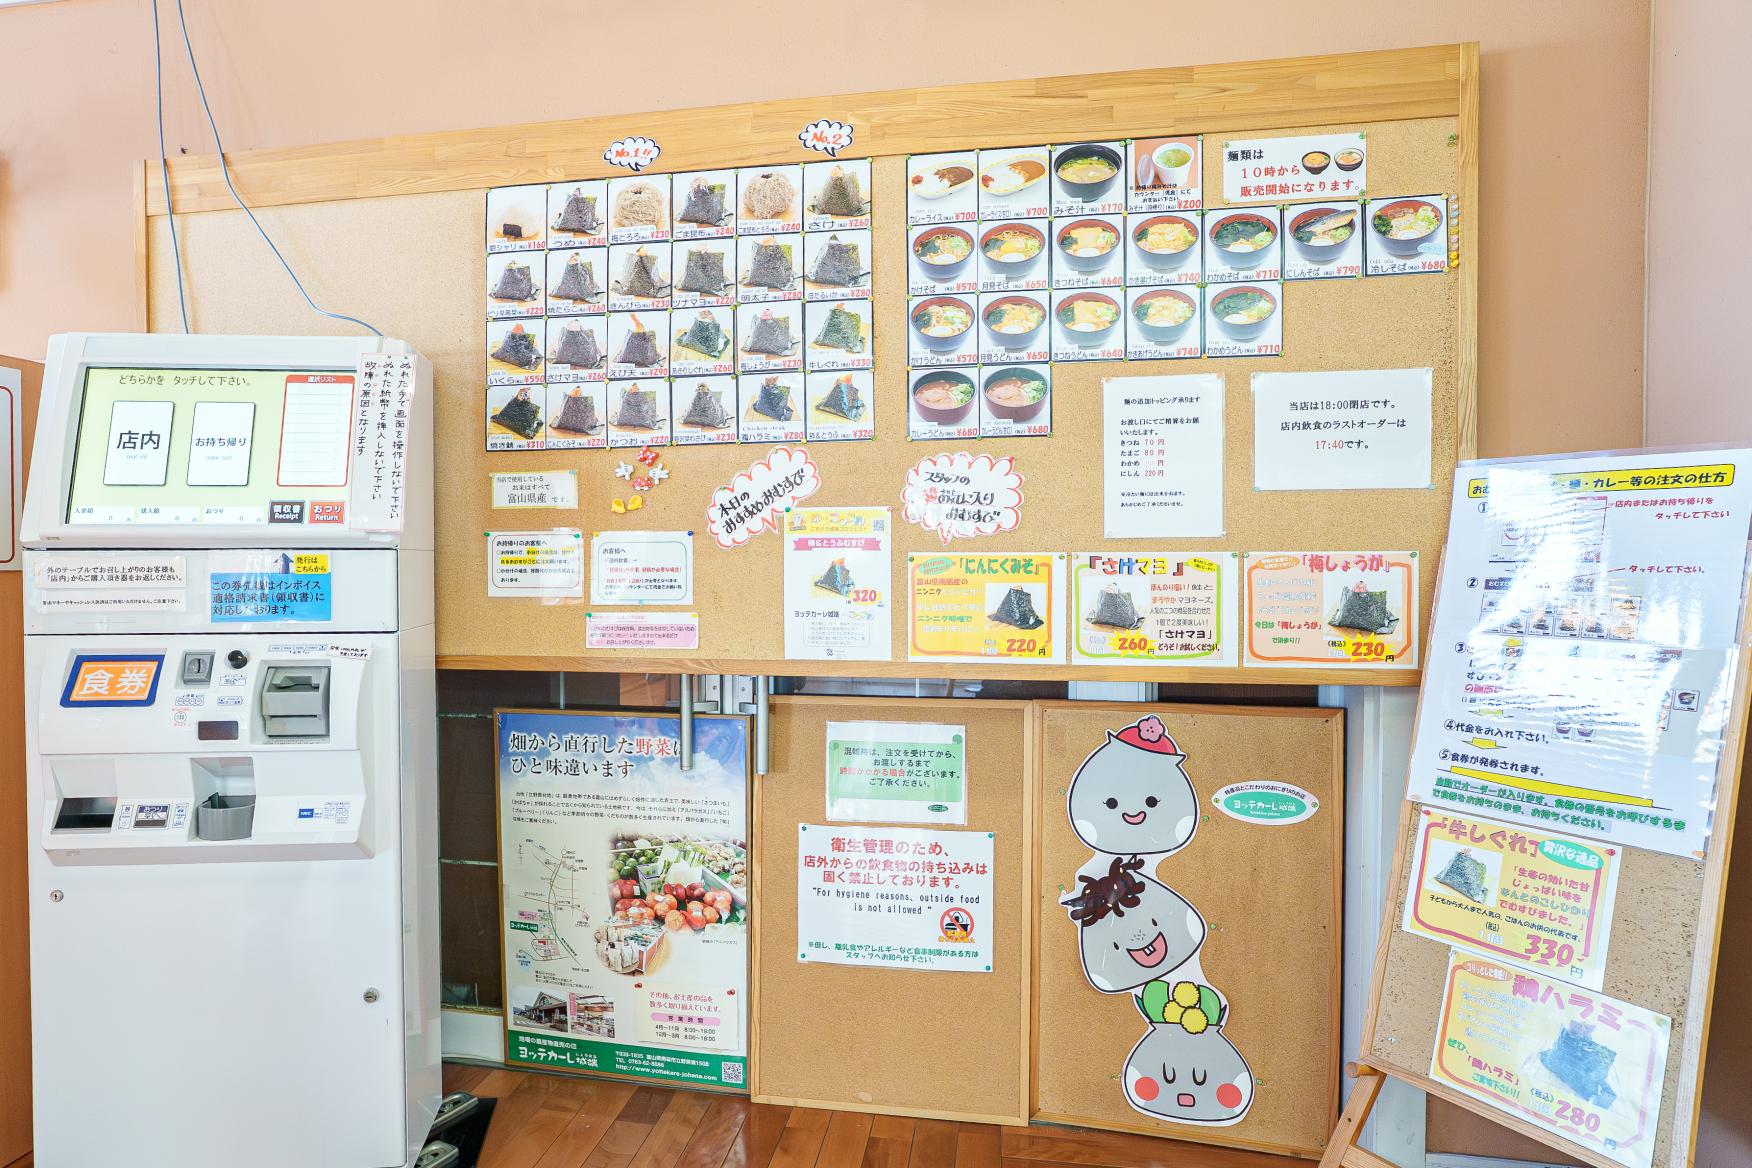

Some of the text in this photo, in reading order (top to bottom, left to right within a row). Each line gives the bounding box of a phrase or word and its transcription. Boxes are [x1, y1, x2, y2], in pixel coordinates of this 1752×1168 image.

[1227, 148, 1265, 162] 麺類は
[1240, 179, 1360, 198] 販売開始になります。
[1053, 203, 1123, 214] みそ汁 ¥170
[1177, 199, 1202, 209] ¥200
[955, 211, 976, 221] ¥700
[1026, 207, 1048, 216] ¥700
[780, 223, 801, 232] ¥240
[808, 218, 869, 229] さけ ¥260
[651, 231, 670, 239] ¥230
[674, 227, 735, 239] ごま昆布 ¥240
[527, 240, 546, 250] ¥160
[587, 237, 606, 245] ¥240
[1371, 259, 1446, 273] 冷しそば ¥680
[1207, 270, 1280, 281] わかめそば ¥710
[1286, 266, 1361, 277] にしんそば ¥790
[1054, 277, 1123, 288] きつねそば ¥640
[1176, 273, 1201, 283] ¥740
[911, 282, 977, 294] かけそば ¥570
[981, 280, 1047, 290] 月見そば ¥650
[741, 291, 803, 302] 明太子 ¥280
[849, 289, 871, 297] ¥280
[610, 300, 670, 309] きんぴら ¥230
[672, 296, 735, 307] ツナマヨ ¥220
[525, 306, 544, 315] ¥220
[587, 304, 606, 312] ¥260
[1176, 347, 1199, 356] ¥740
[1256, 344, 1280, 353] ¥710
[911, 353, 978, 366] かけうどん ¥570
[980, 351, 1048, 362] 月見うどん ¥650
[1053, 349, 1123, 360] きつねうどん ¥640
[713, 364, 733, 372] ¥260
[782, 360, 802, 368] ¥230
[850, 359, 871, 367] ¥330
[547, 372, 606, 382] さけマヨ ¥260
[609, 368, 668, 377] えび天 ¥290
[119, 375, 165, 386] どちらかを
[489, 375, 545, 385] いくら ¥550
[1288, 399, 1396, 411] 当店は18:00閉店です。
[1027, 425, 1049, 434] ¥680
[1280, 418, 1407, 431] 店内飲食のラストオーダーは
[715, 433, 736, 441] ¥230
[783, 431, 804, 440] ¥280
[852, 429, 874, 438] ¥320
[956, 427, 978, 437] ¥680
[116, 430, 161, 450] 店内
[195, 437, 247, 448] お持ち帰り
[526, 440, 545, 448] ¥310
[586, 438, 606, 446] ¥220
[649, 436, 669, 444] ¥220
[1315, 439, 1369, 450] 17:40です。
[512, 483, 551, 491] お米はすべて
[718, 491, 751, 518] 本日の
[1614, 496, 1715, 508] 店内またはお持ち帰りを
[314, 504, 342, 513] おつり
[274, 512, 339, 521] Receipt Return
[1656, 510, 1731, 519] タッチして下さい
[296, 556, 318, 564] 発行は
[47, 566, 175, 574] 外のテーブルでお召し上がりのお客様も
[296, 565, 328, 573] こちらから
[212, 579, 321, 591] この券売機はインボイス
[853, 589, 877, 602] 320
[1159, 629, 1213, 640] 「さけマヨ」
[79, 668, 149, 695] 食券
[511, 757, 635, 777] ひと味違います
[873, 759, 932, 768] お渡しするまで
[869, 778, 931, 788] ご了承ください。
[831, 837, 950, 858] 衛生管理のため、
[804, 855, 988, 875] 店外からの飲食物の持ち込みは
[823, 870, 961, 890] 固く禁止しております。
[836, 889, 870, 900] hygiene
[920, 894, 954, 903] outside
[961, 895, 980, 904] food
[854, 903, 922, 915] is not allowed
